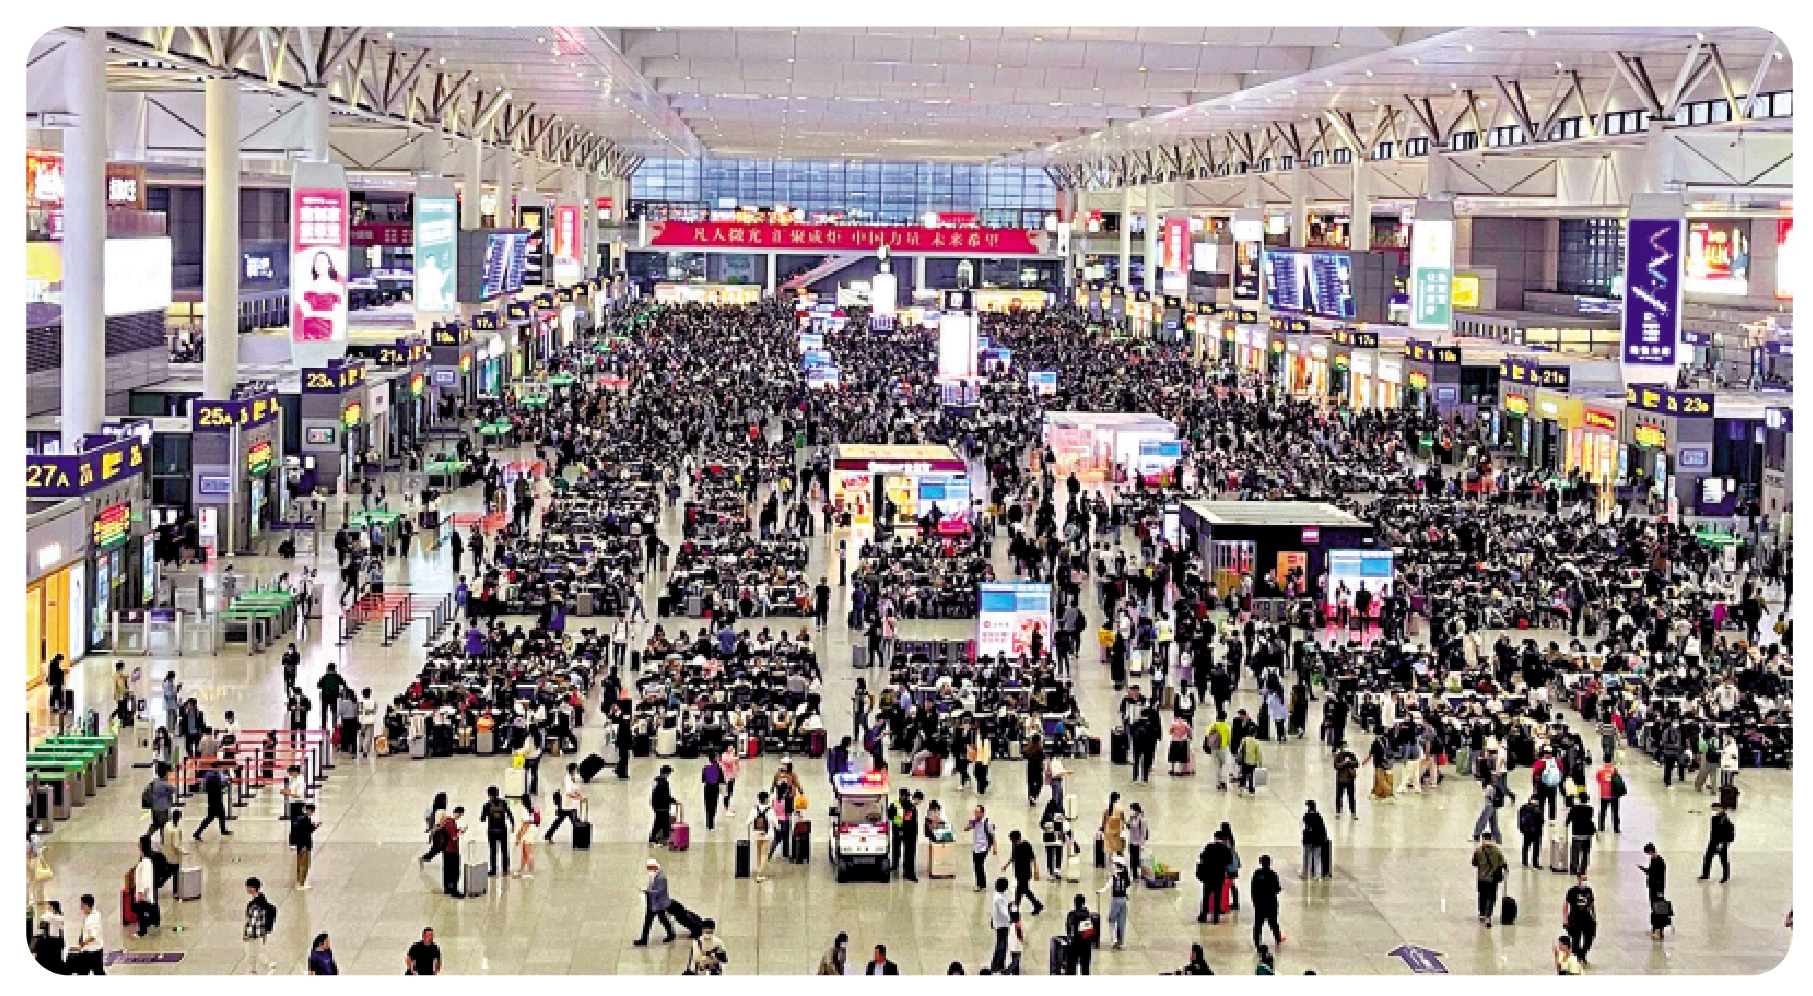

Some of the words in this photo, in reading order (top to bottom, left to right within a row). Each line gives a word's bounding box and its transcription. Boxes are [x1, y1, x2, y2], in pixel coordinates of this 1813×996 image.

[306, 372, 335, 388] 23A
[199, 407, 232, 425] 25A
[25, 463, 71, 487] 27A
